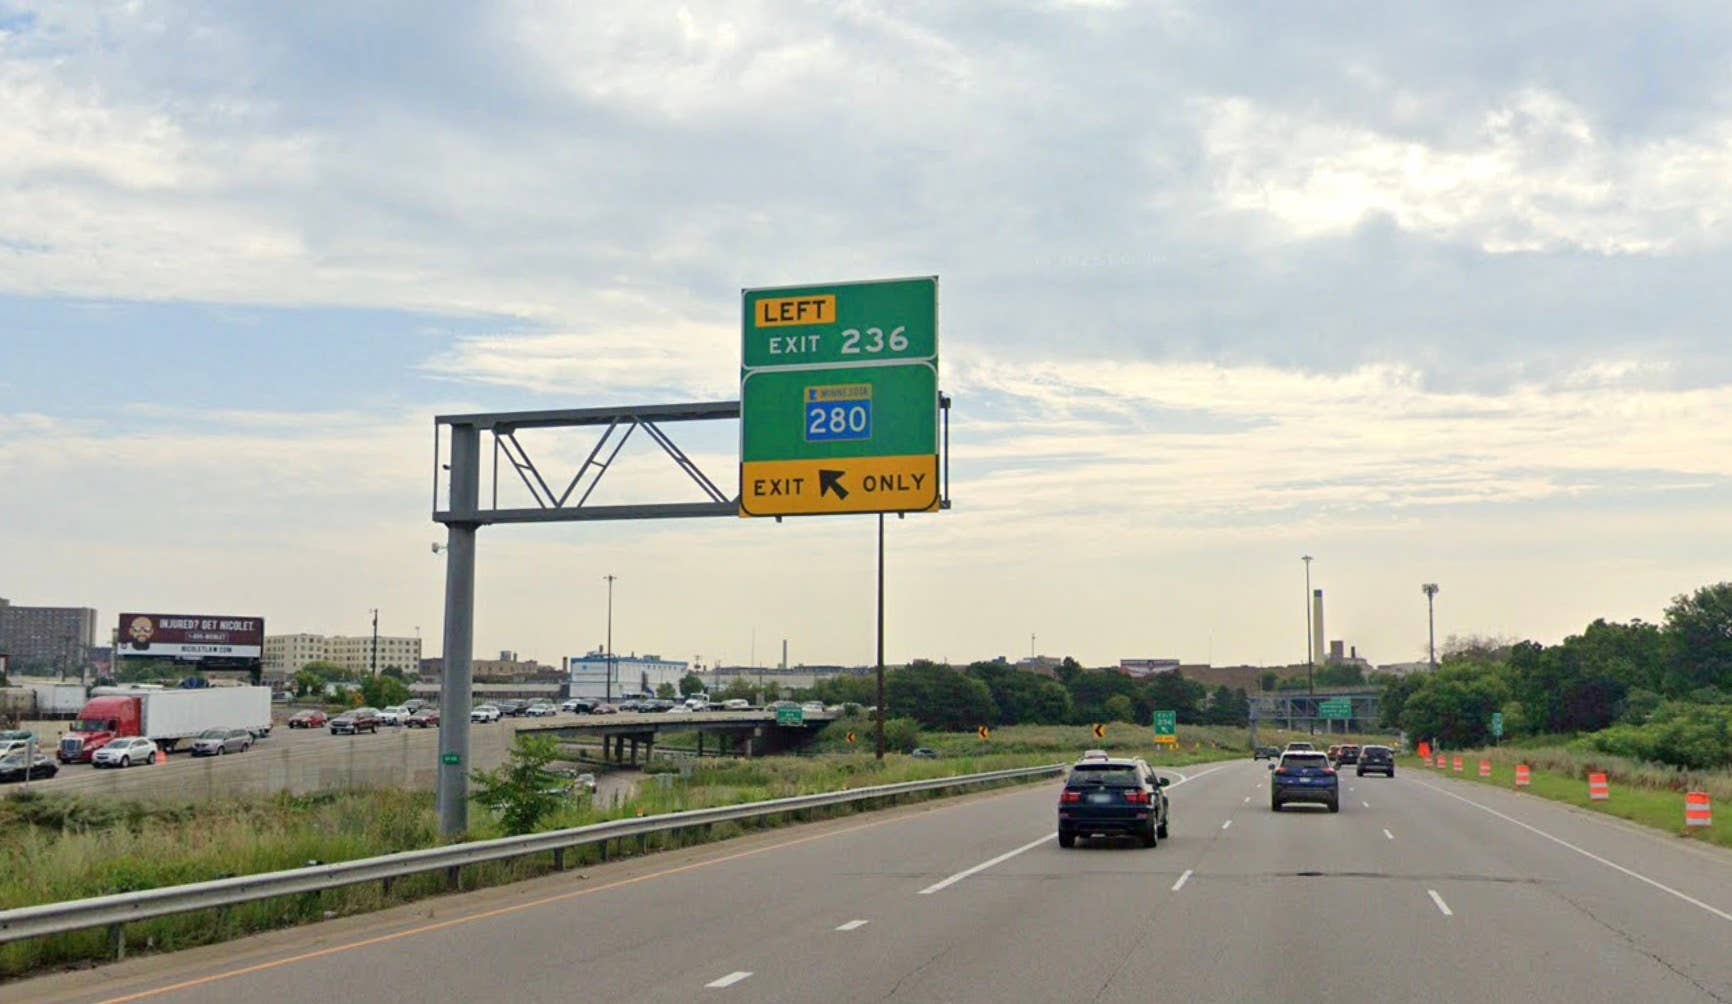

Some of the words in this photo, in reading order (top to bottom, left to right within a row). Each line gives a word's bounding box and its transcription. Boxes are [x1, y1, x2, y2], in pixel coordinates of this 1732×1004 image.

[764, 300, 826, 322] LEFT
[769, 335, 821, 354] EXIT
[841, 326, 909, 354] 236
[810, 406, 866, 434] 280
[754, 479, 804, 496] EXIT
[863, 474, 926, 492] ONLY
[159, 619, 199, 630] INJURED?
[202, 620, 218, 630] GET
